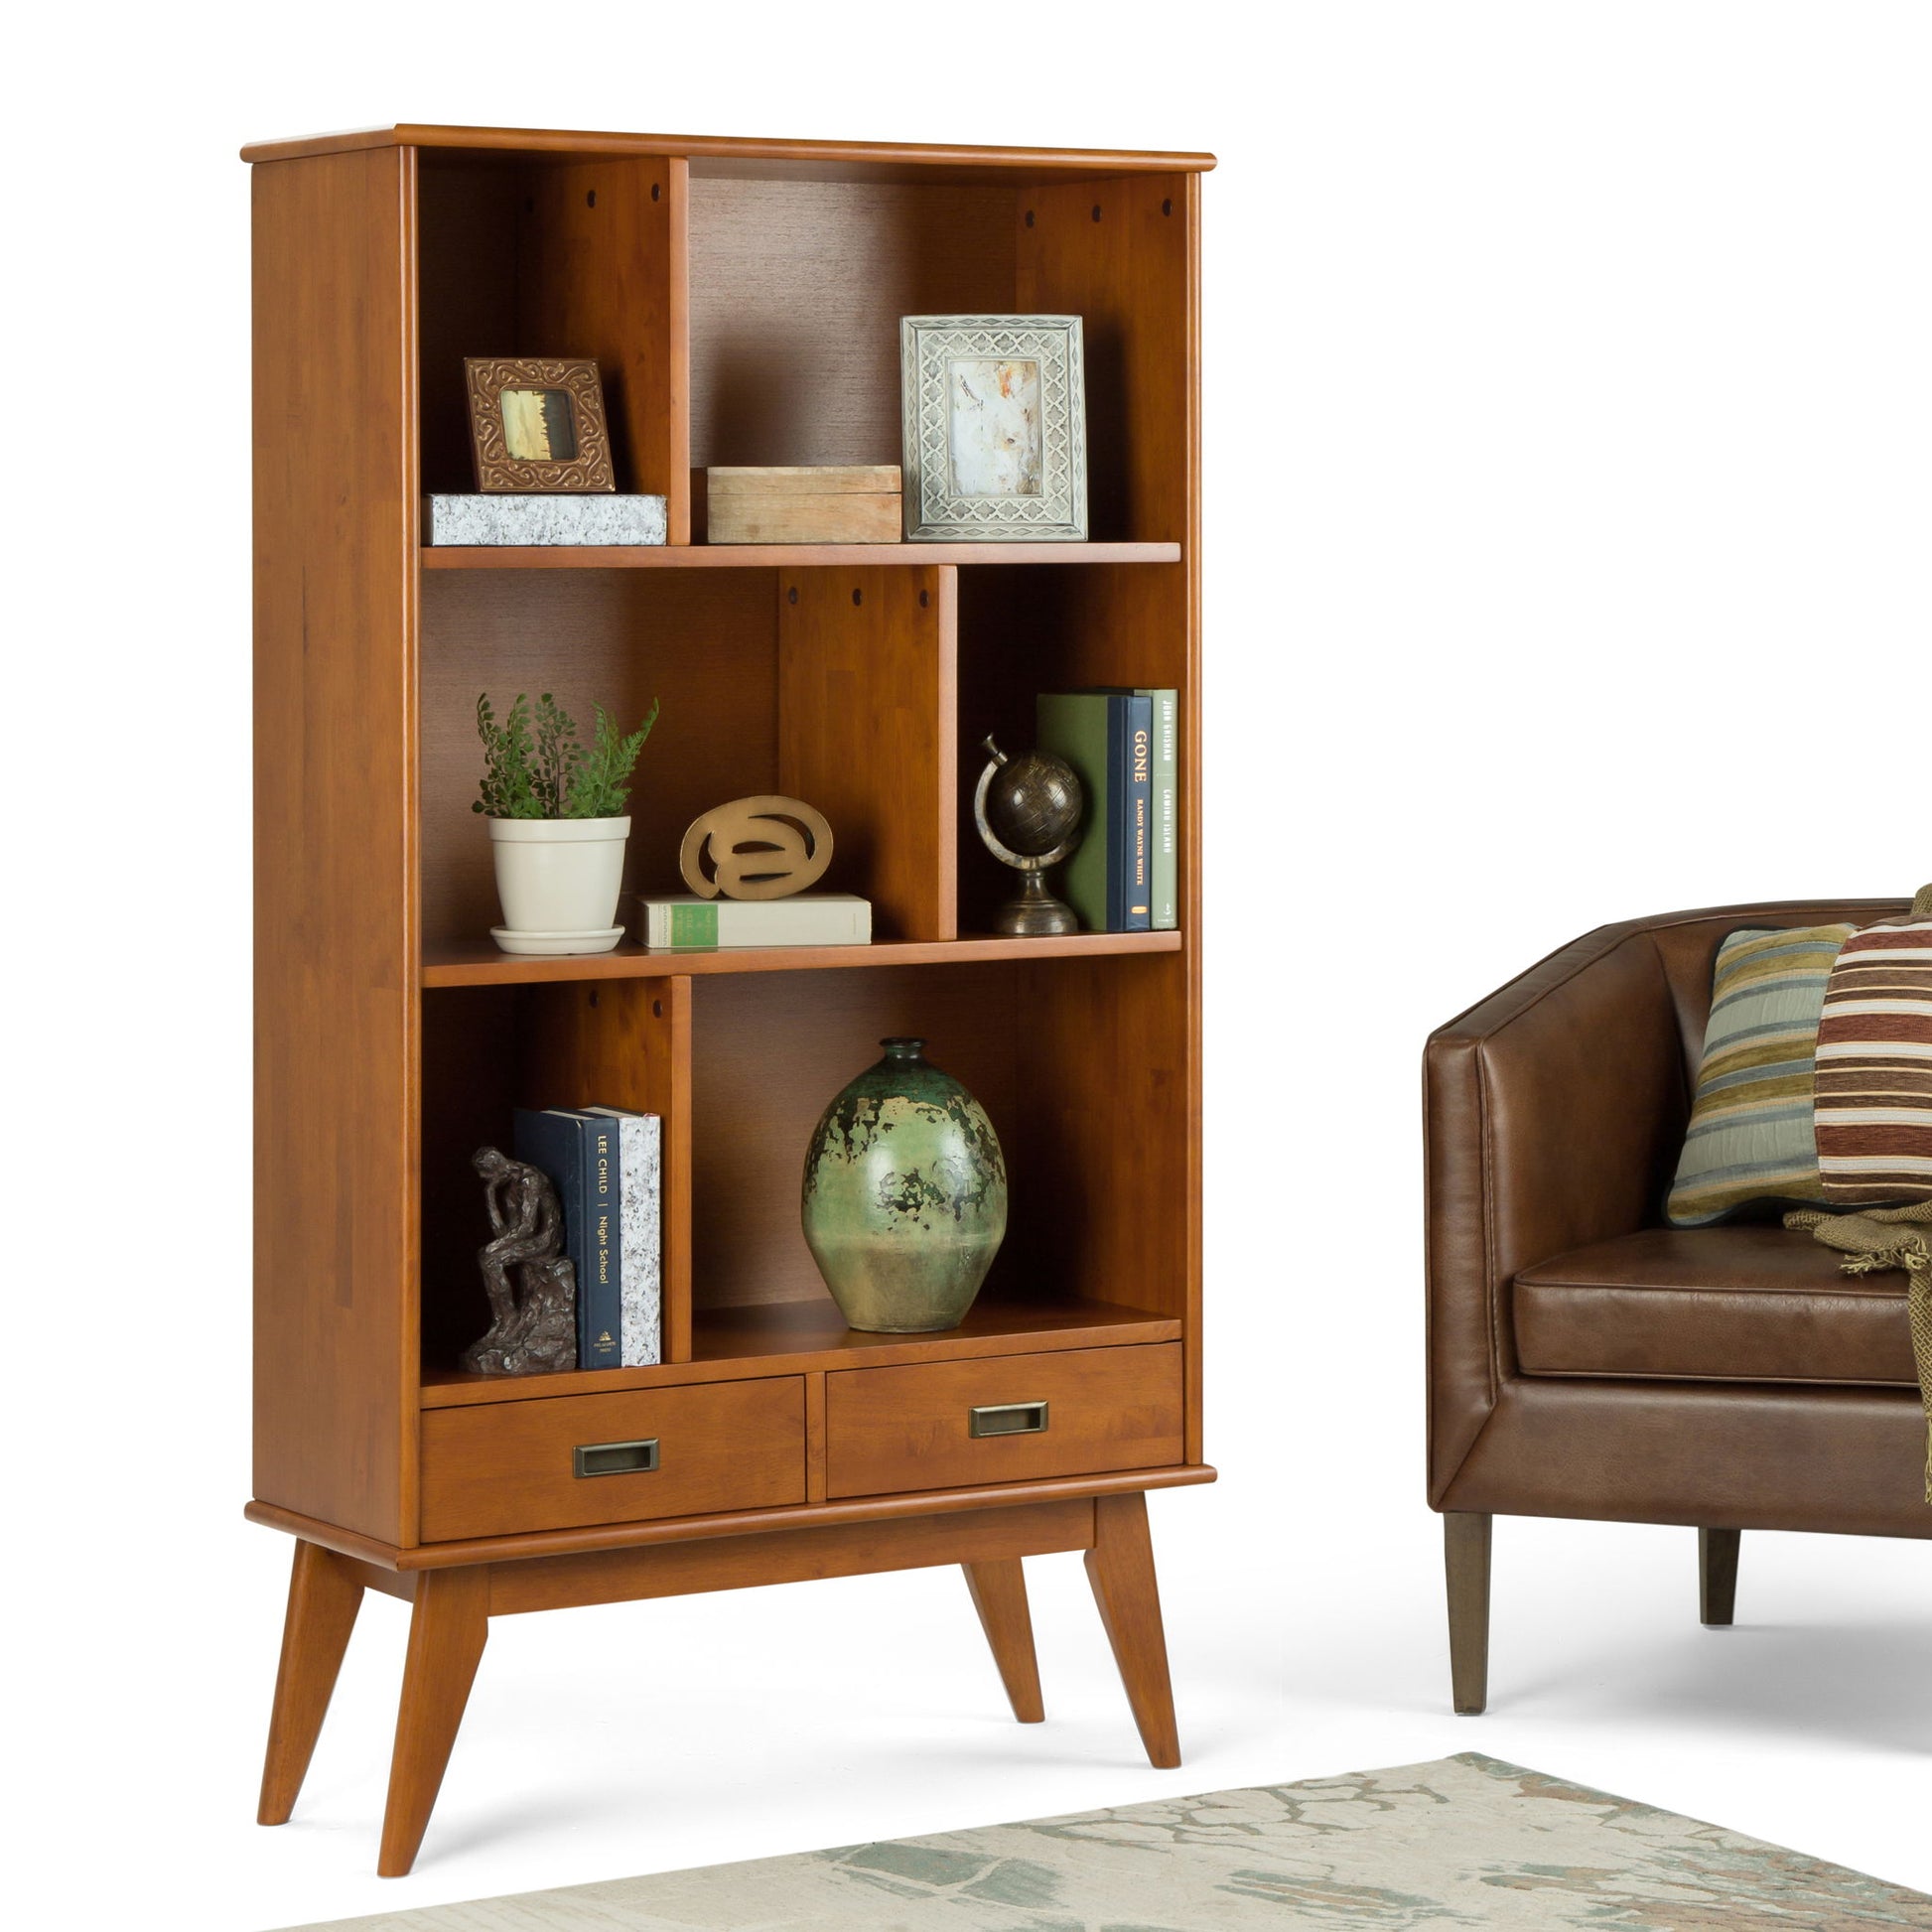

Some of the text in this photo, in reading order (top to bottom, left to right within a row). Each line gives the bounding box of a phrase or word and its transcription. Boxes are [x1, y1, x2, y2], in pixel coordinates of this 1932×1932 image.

[1134, 730, 1148, 782] GONE
[597, 1135, 609, 1284] LEE CHILD Night School
